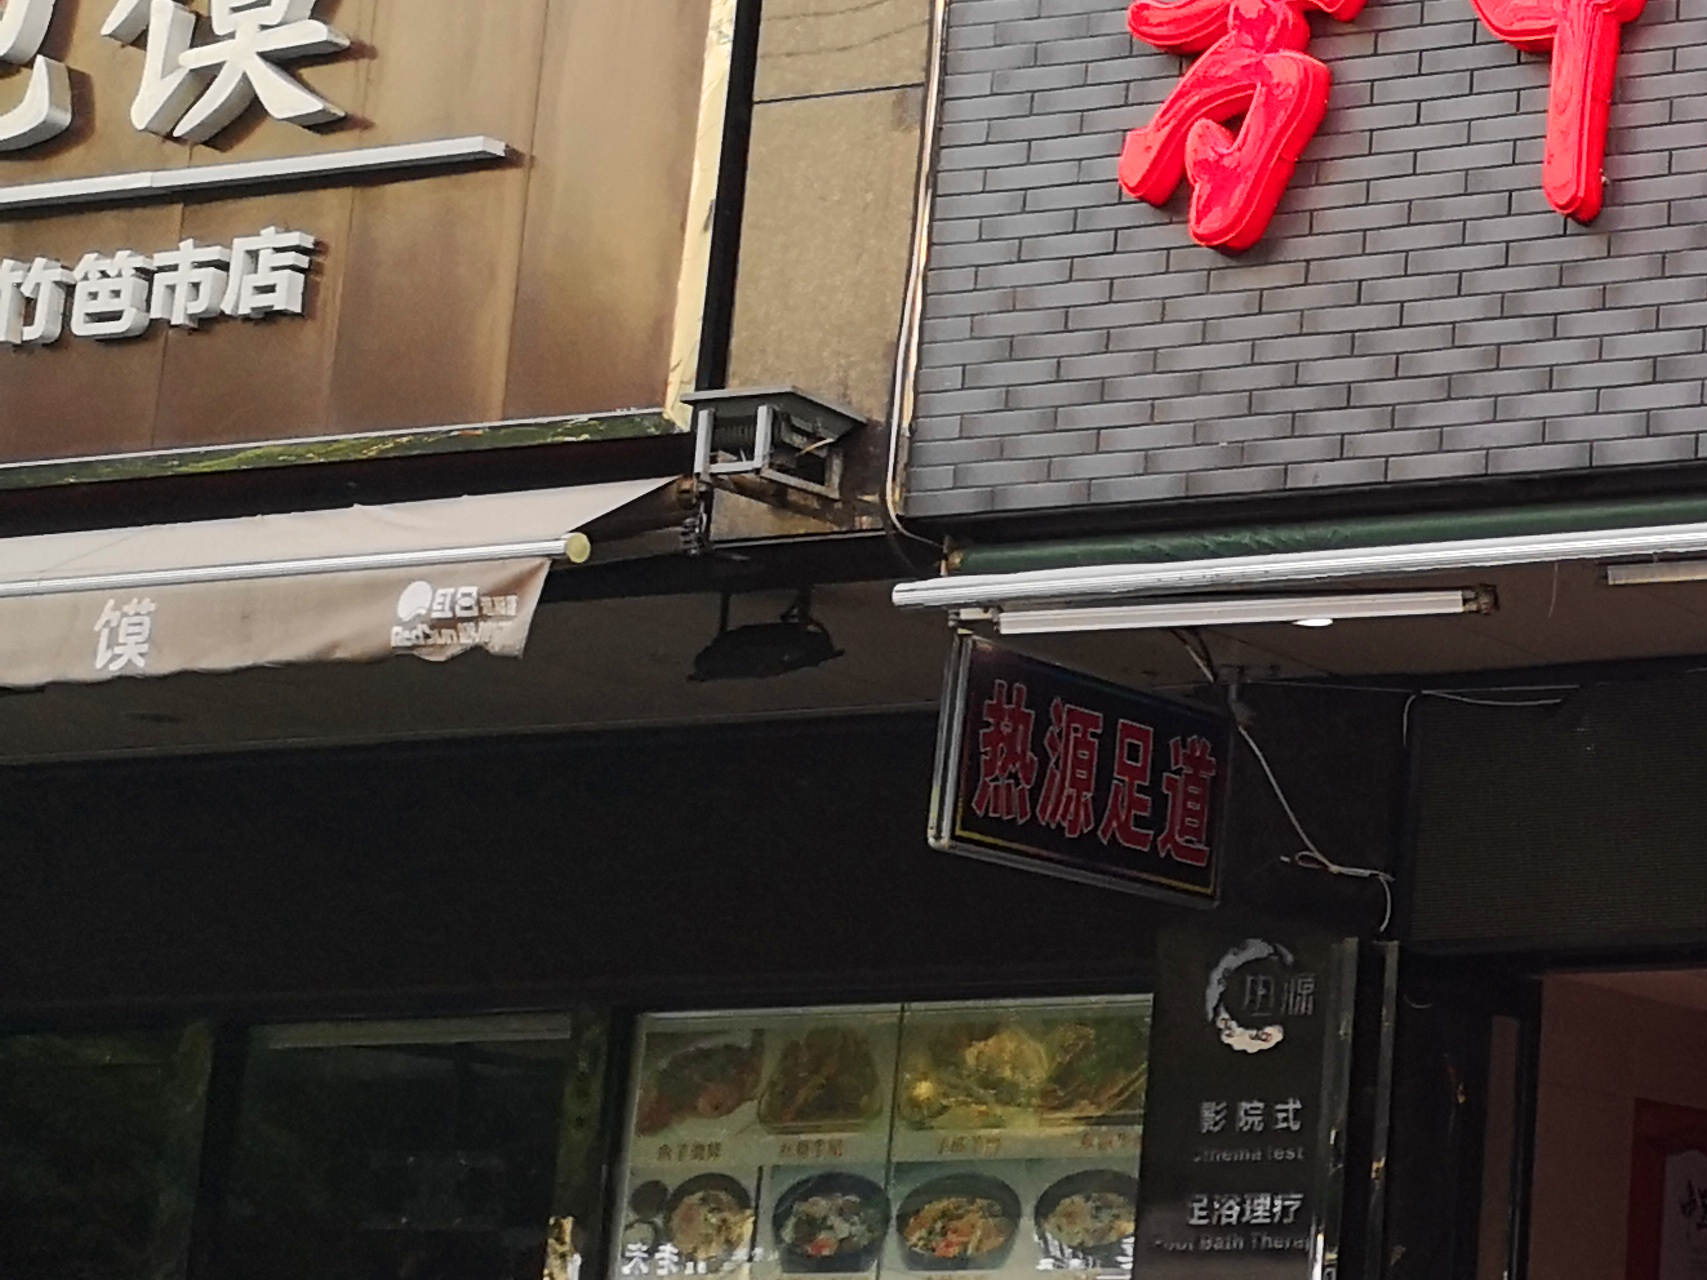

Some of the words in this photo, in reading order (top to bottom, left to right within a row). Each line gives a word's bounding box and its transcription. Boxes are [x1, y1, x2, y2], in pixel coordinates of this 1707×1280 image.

[93, 596, 158, 672] 馍
[972, 679, 1217, 867] 热源足道
